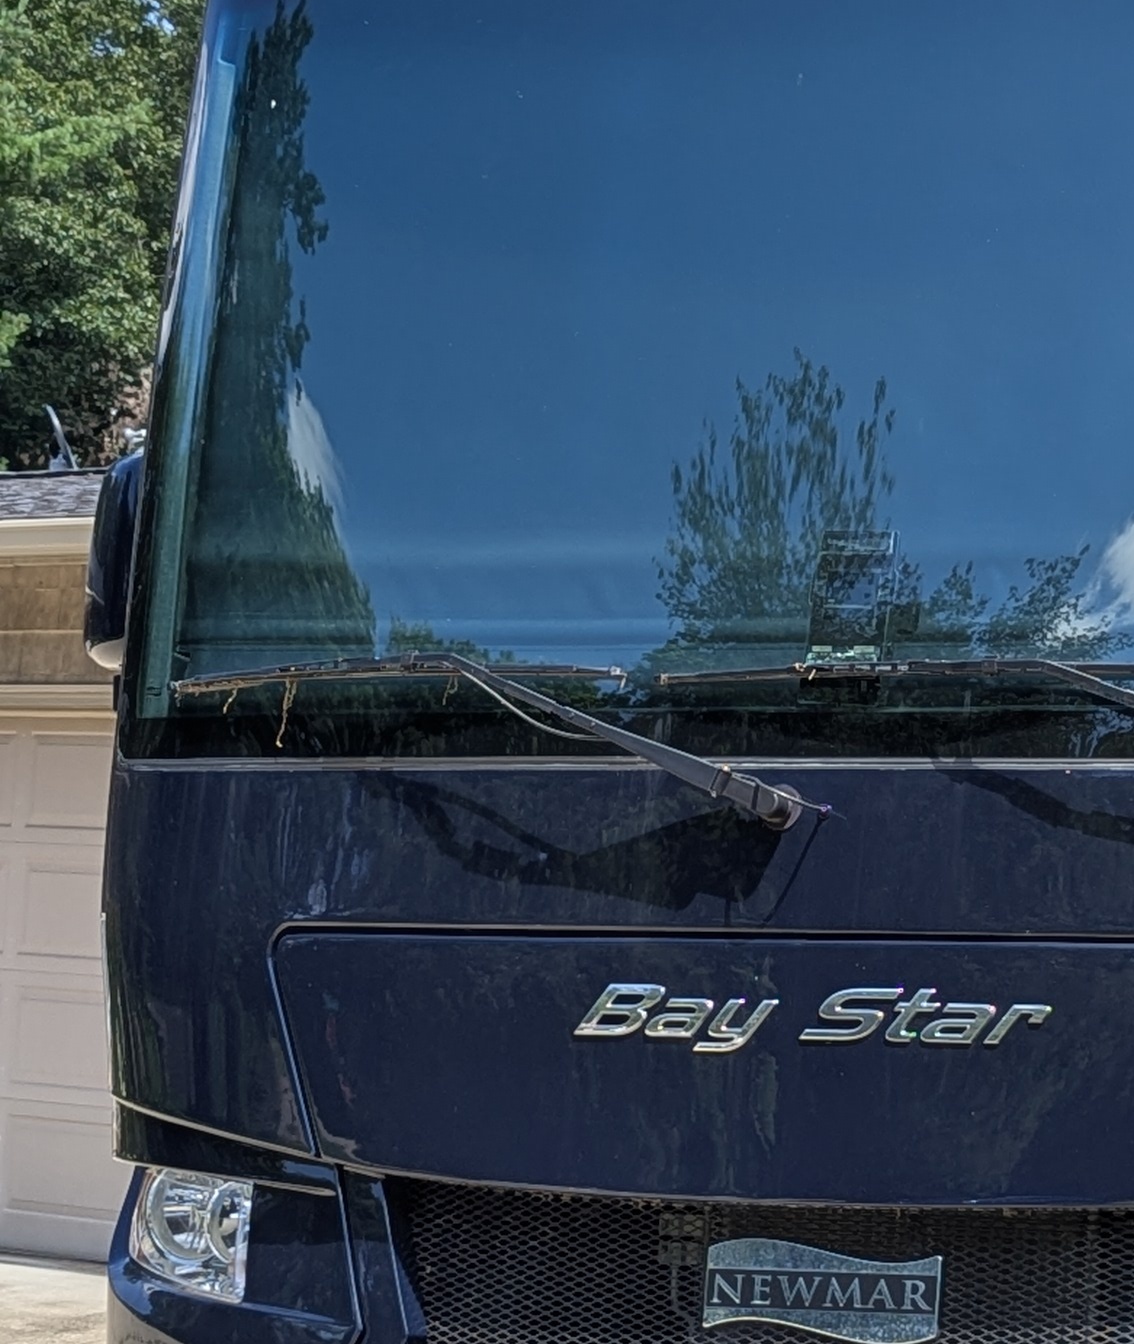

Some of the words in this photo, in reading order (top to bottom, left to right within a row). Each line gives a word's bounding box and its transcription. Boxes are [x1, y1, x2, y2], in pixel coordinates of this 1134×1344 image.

[573, 983, 779, 1053] Bay
[798, 986, 1052, 1045] Star
[710, 1273, 933, 1311] NEWMAR
